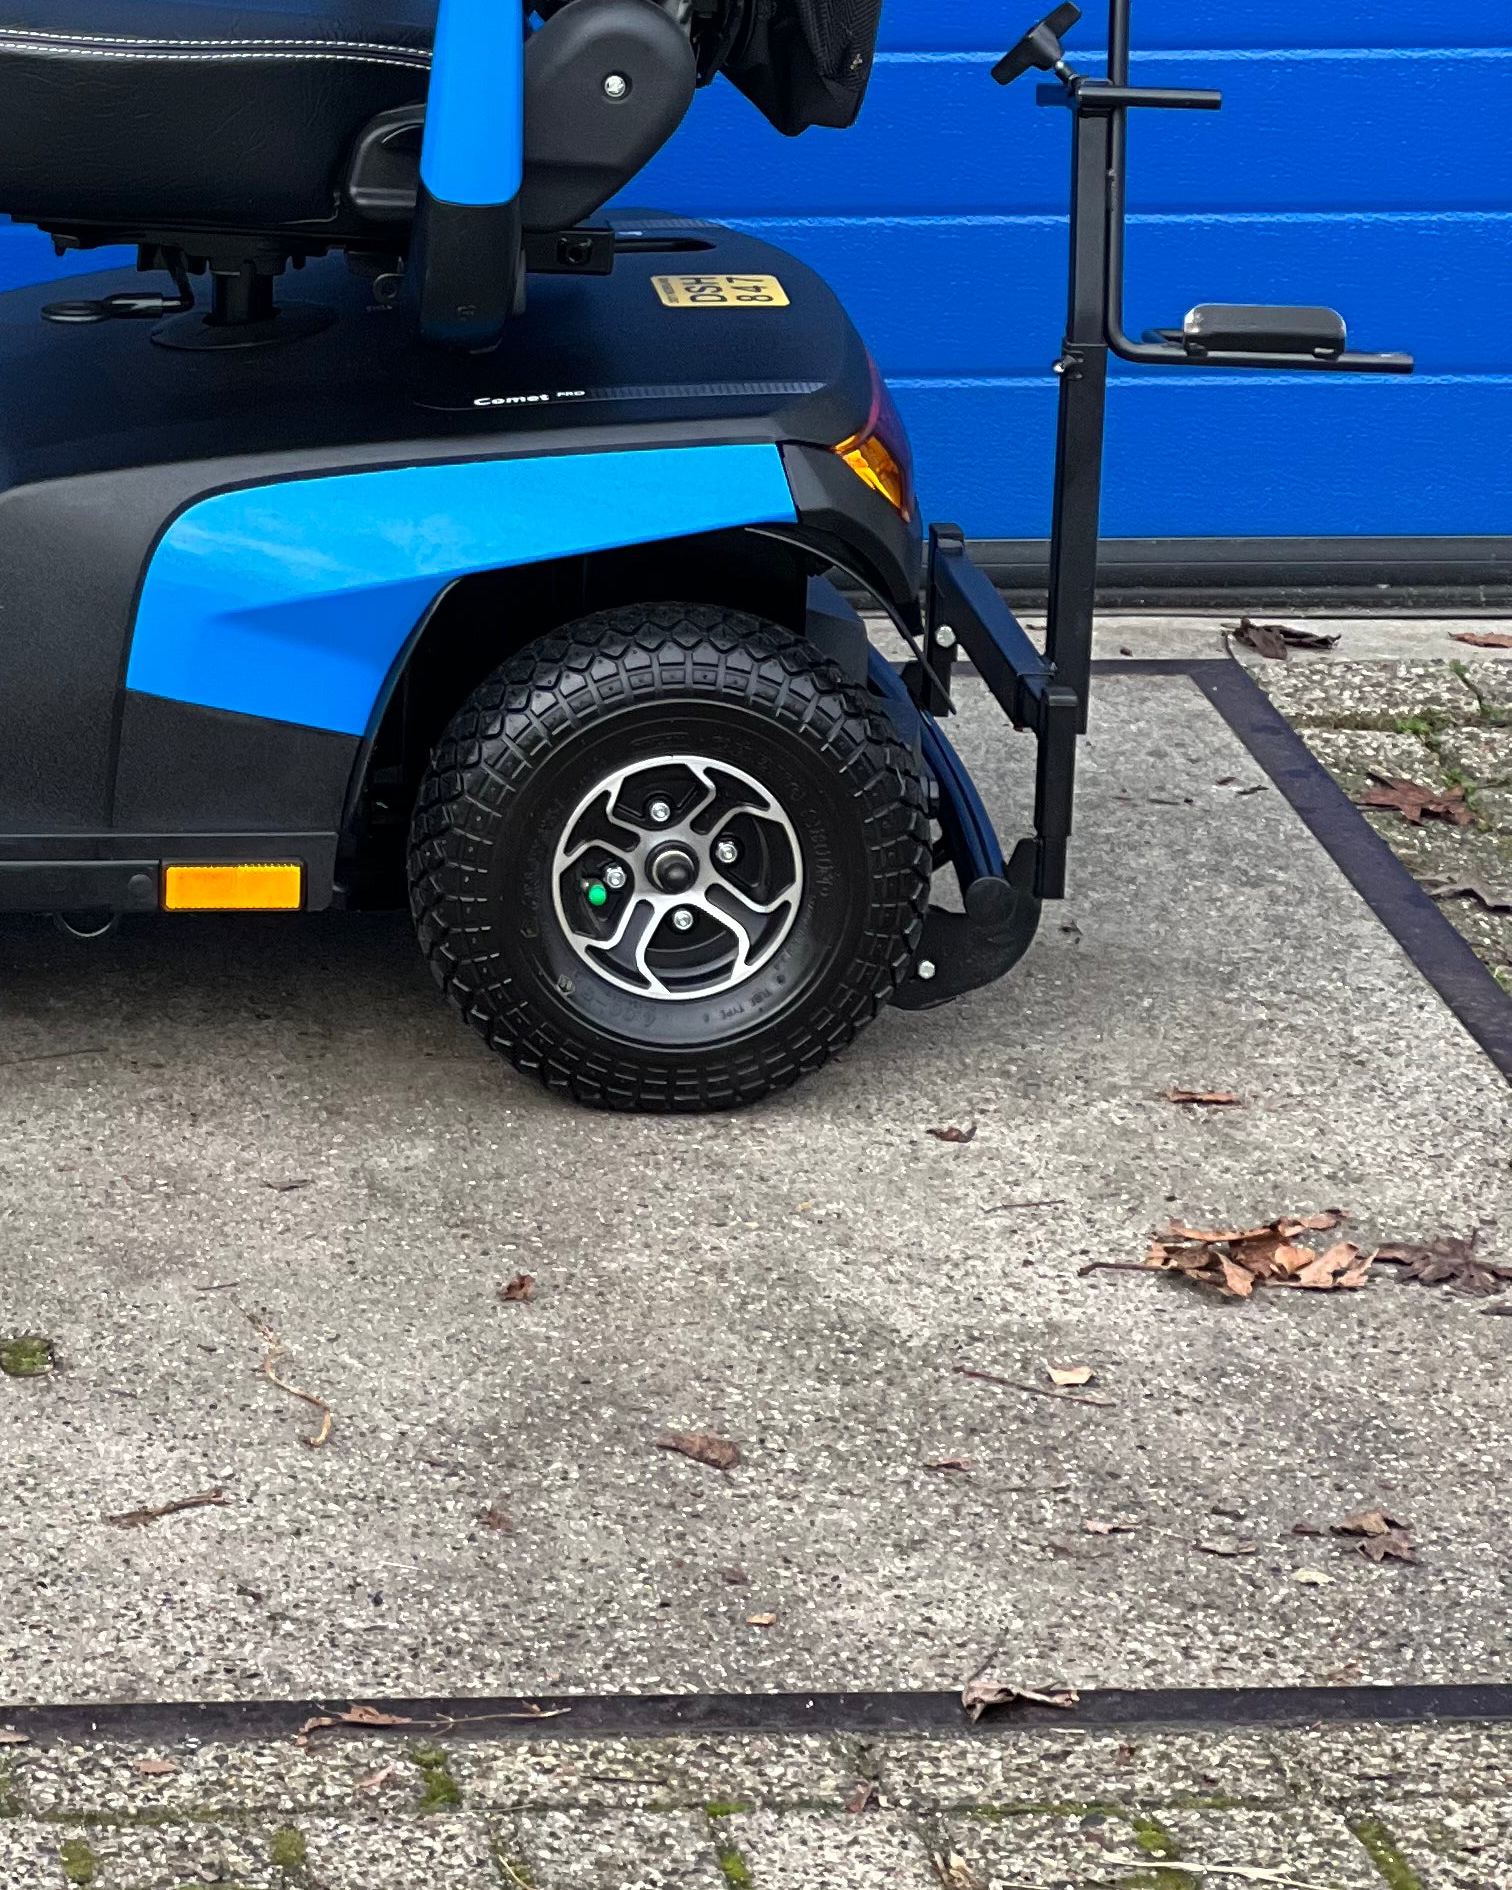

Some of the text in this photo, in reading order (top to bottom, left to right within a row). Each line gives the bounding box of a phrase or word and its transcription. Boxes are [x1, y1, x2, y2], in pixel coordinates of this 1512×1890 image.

[679, 277, 728, 302] DSH
[725, 277, 774, 302] 847
[473, 389, 585, 407] Comet PRO
